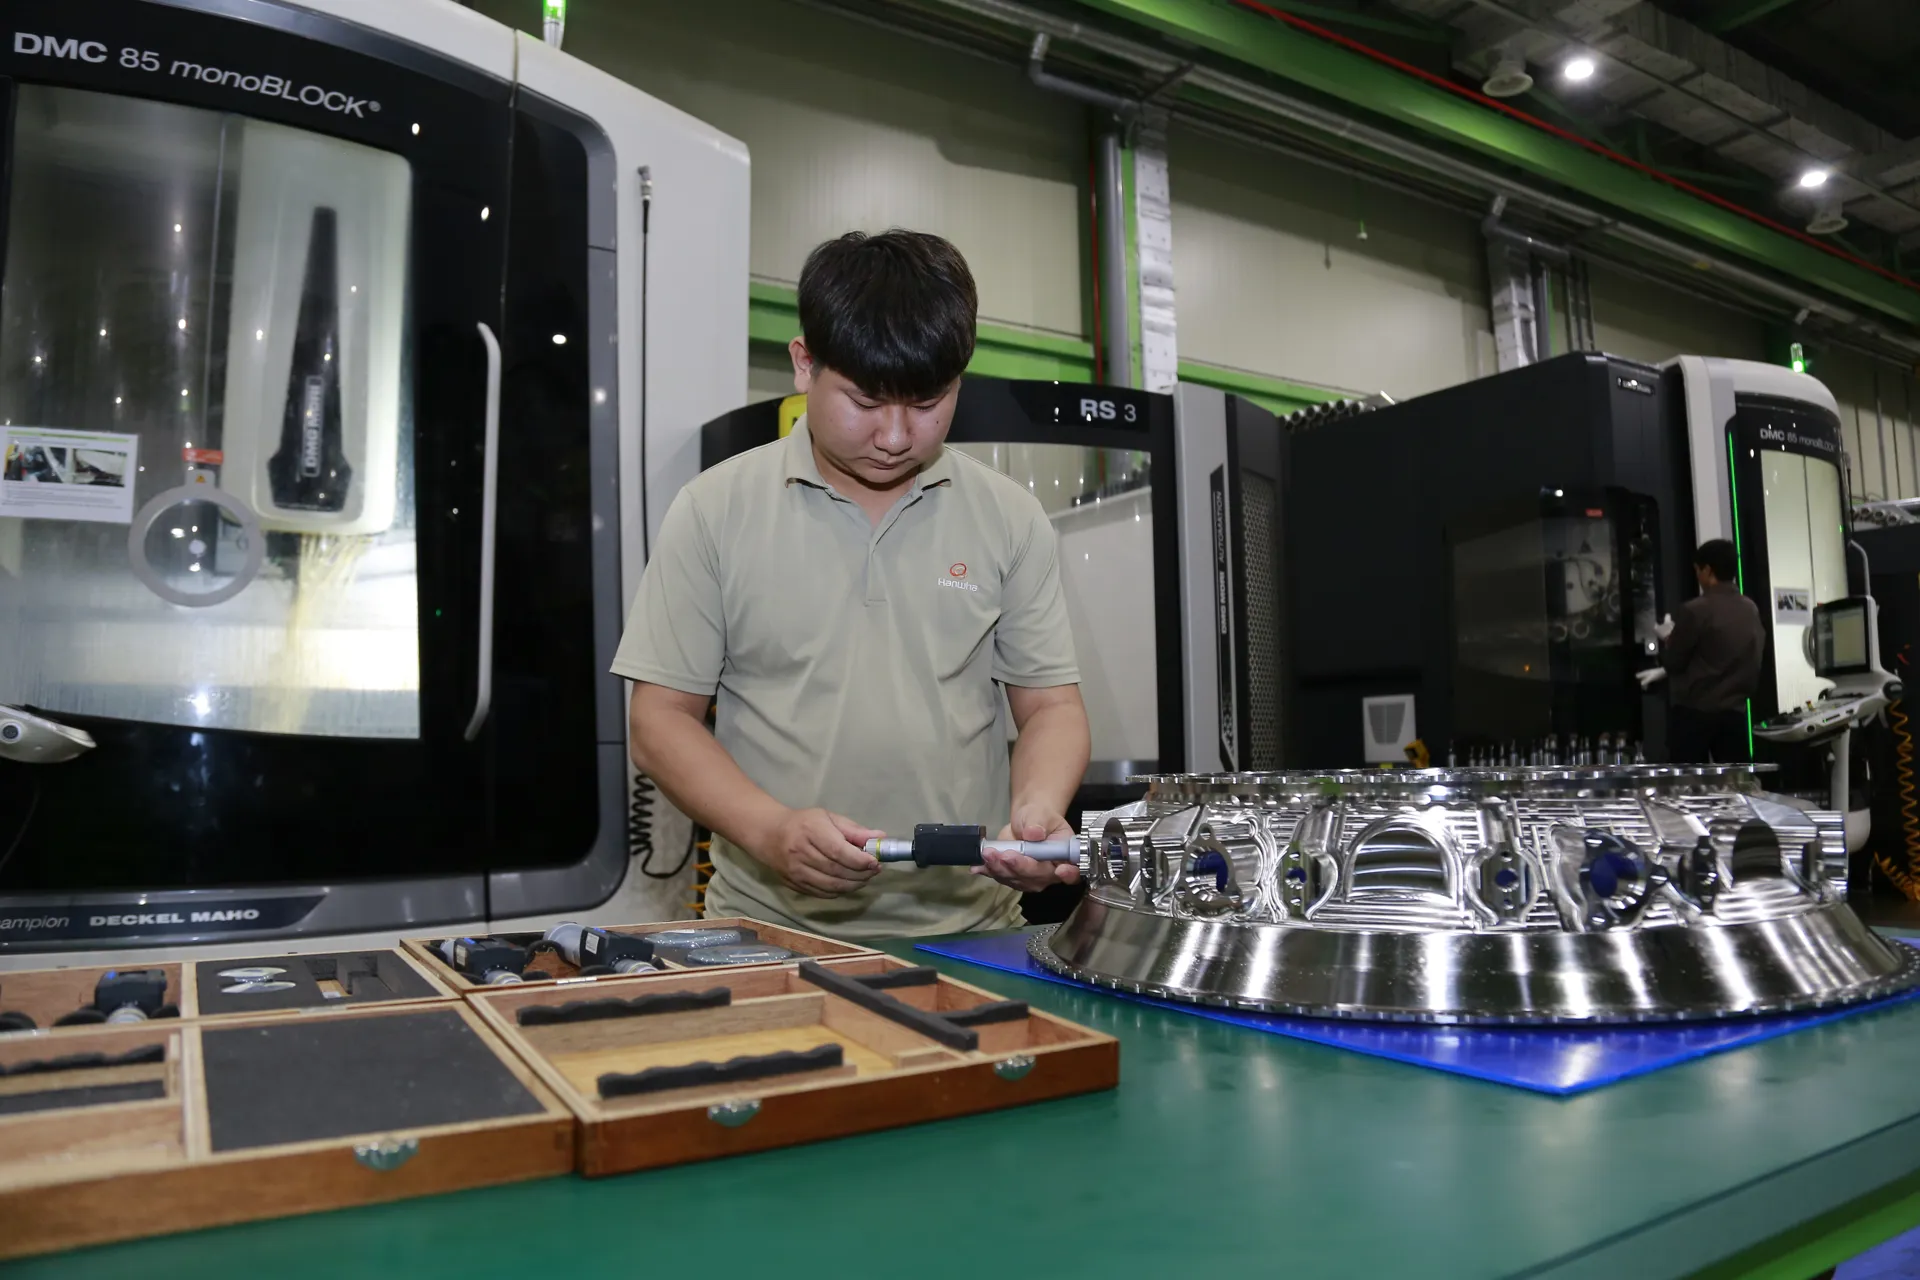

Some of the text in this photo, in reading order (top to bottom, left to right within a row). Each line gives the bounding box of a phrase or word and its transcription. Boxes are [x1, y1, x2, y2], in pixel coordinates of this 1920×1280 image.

[14, 32, 108, 63] DMC
[119, 48, 160, 71] 85
[1080, 399, 1137, 422] RS 3
[1760, 428, 1785, 441] DMC
[1216, 491, 1225, 563] AUTOMATION
[937, 578, 978, 592] Hanwha
[0, 909, 260, 932] ampion DECKEL MAHO
